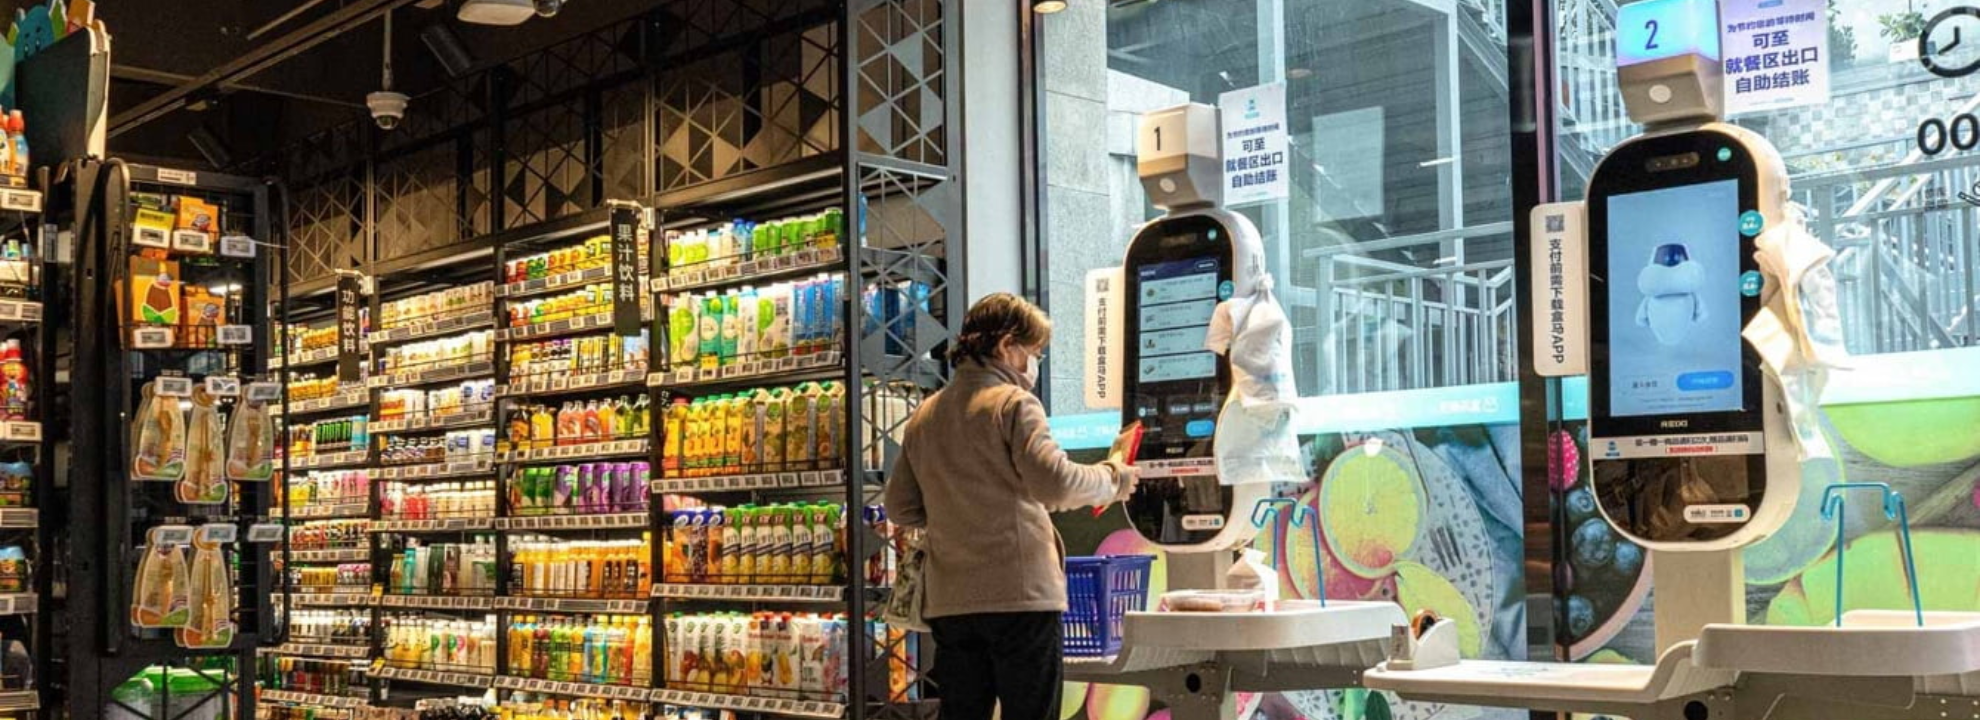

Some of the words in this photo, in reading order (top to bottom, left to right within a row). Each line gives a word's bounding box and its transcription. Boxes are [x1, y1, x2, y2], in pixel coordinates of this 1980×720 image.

[1644, 19, 1659, 50] 2
[1752, 30, 1790, 49] 可至
[1725, 47, 1818, 74] 就餐区出口
[1735, 69, 1810, 94] 自助结账
[1154, 126, 1161, 151] 1
[1242, 137, 1265, 153] 可至
[1226, 152, 1283, 174] 就餐区出口
[1231, 169, 1277, 188] 自助结账
[617, 223, 635, 302] 果汁饮料
[342, 288, 355, 353] 功能饮料
